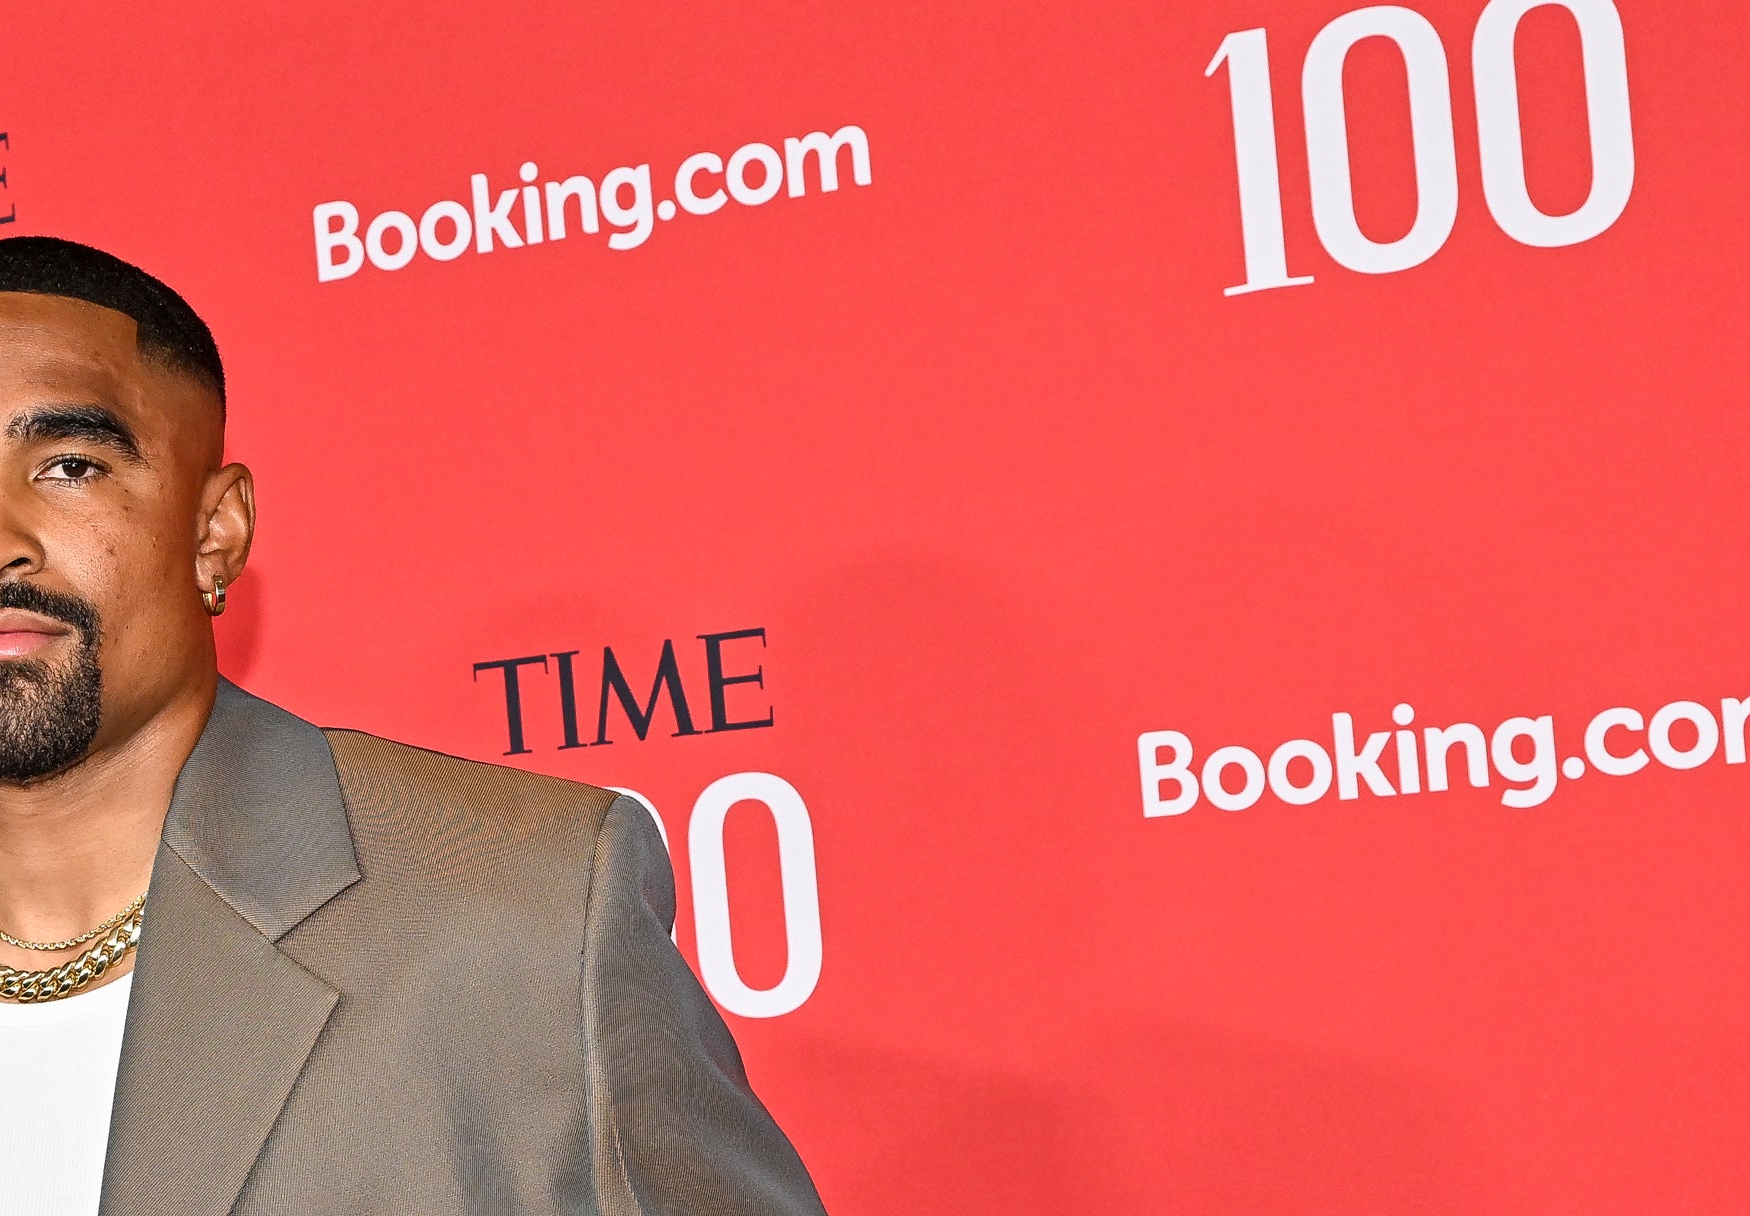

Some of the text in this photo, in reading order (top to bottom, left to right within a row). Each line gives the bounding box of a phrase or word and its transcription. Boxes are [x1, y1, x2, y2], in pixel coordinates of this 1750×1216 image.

[312, 125, 873, 283] Booking.com
[1204, 0, 1636, 297] 100
[472, 627, 775, 757] TIME
